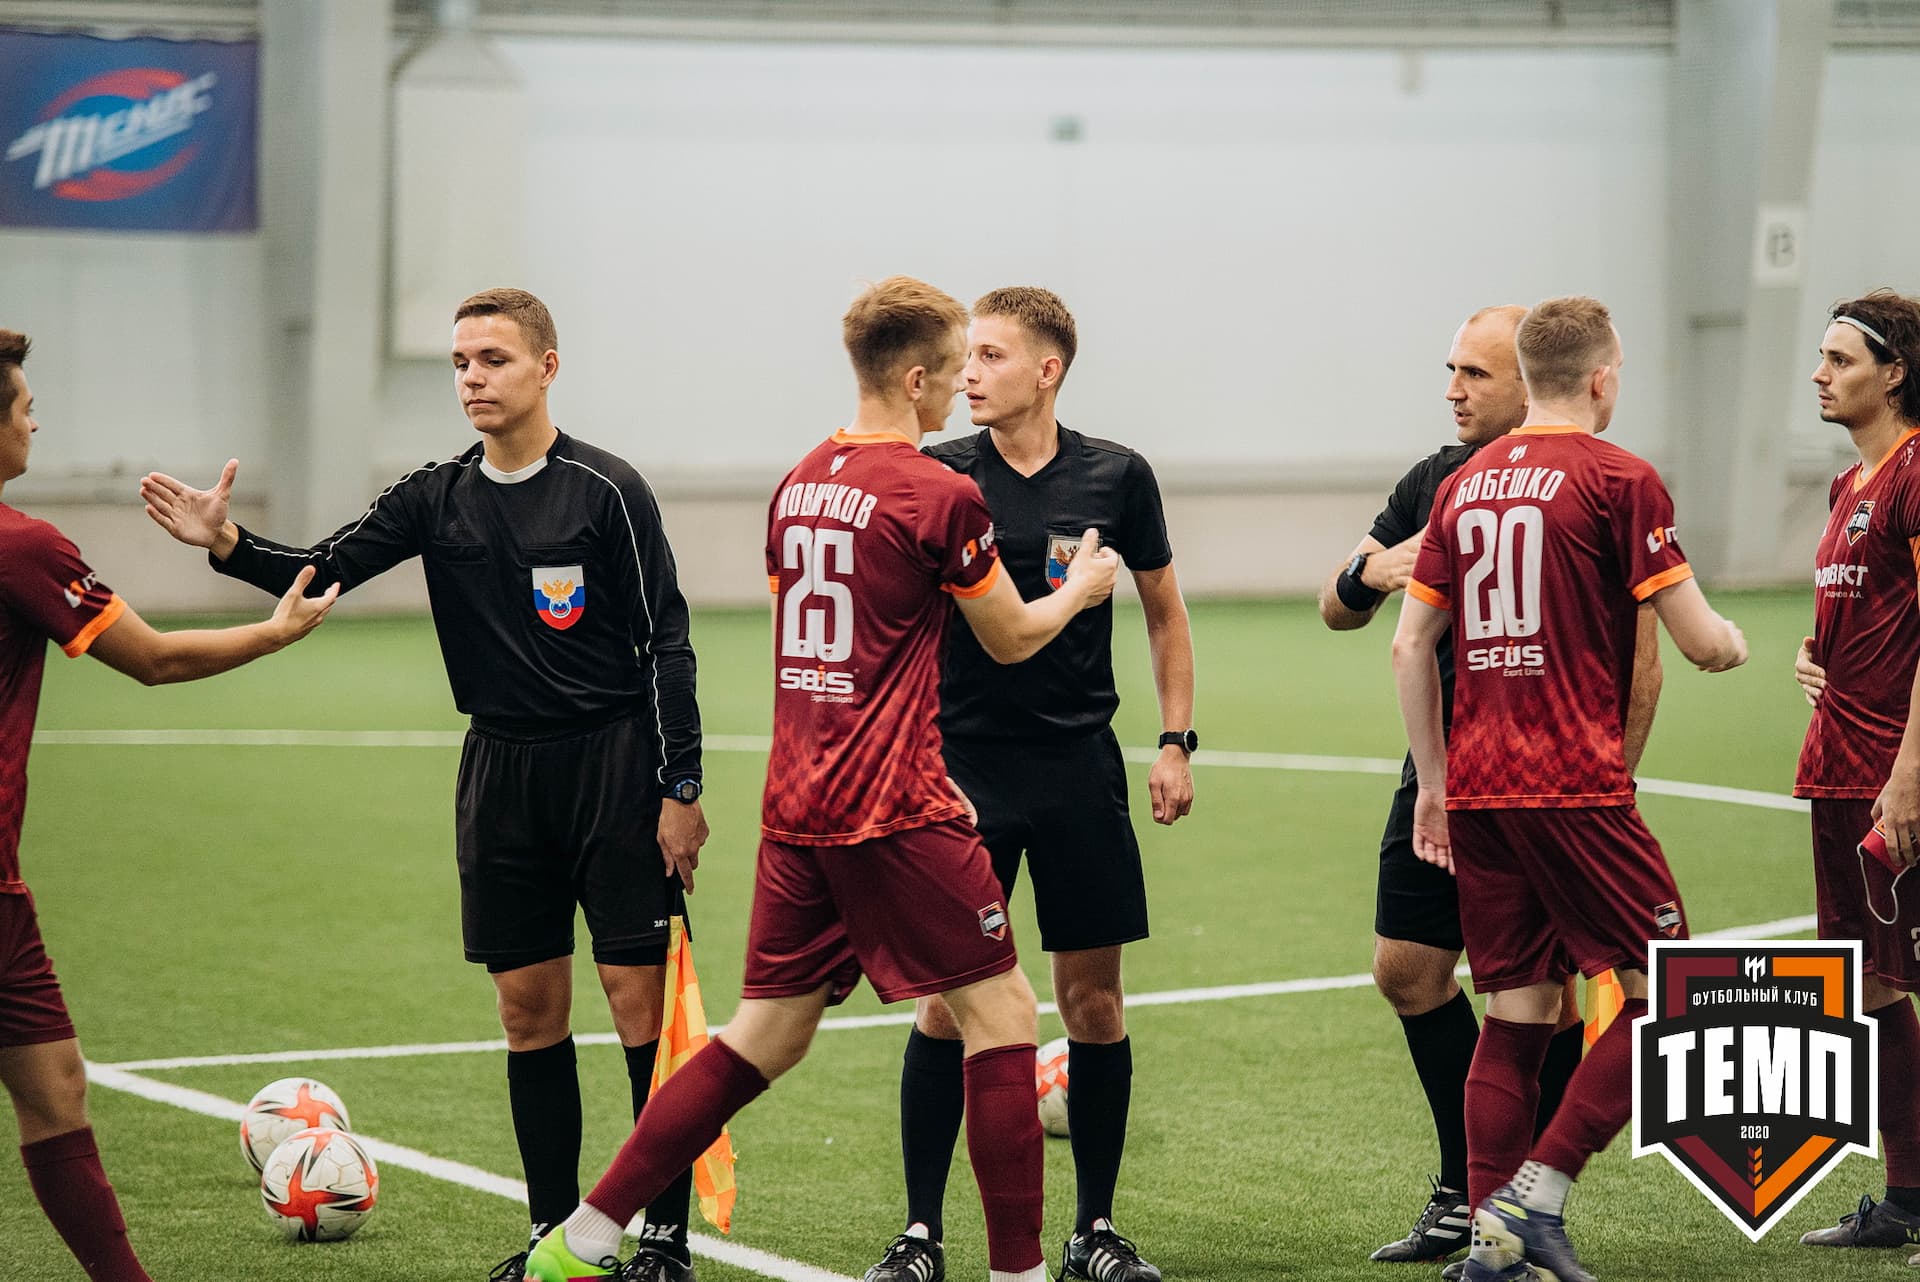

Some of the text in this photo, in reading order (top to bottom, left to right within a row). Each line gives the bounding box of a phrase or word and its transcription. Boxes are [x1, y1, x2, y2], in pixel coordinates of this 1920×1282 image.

[1454, 466, 1566, 510] БОБЕШКО
[781, 524, 855, 663] 25
[1456, 505, 1544, 641] 20
[642, 1223, 679, 1243] 2K
